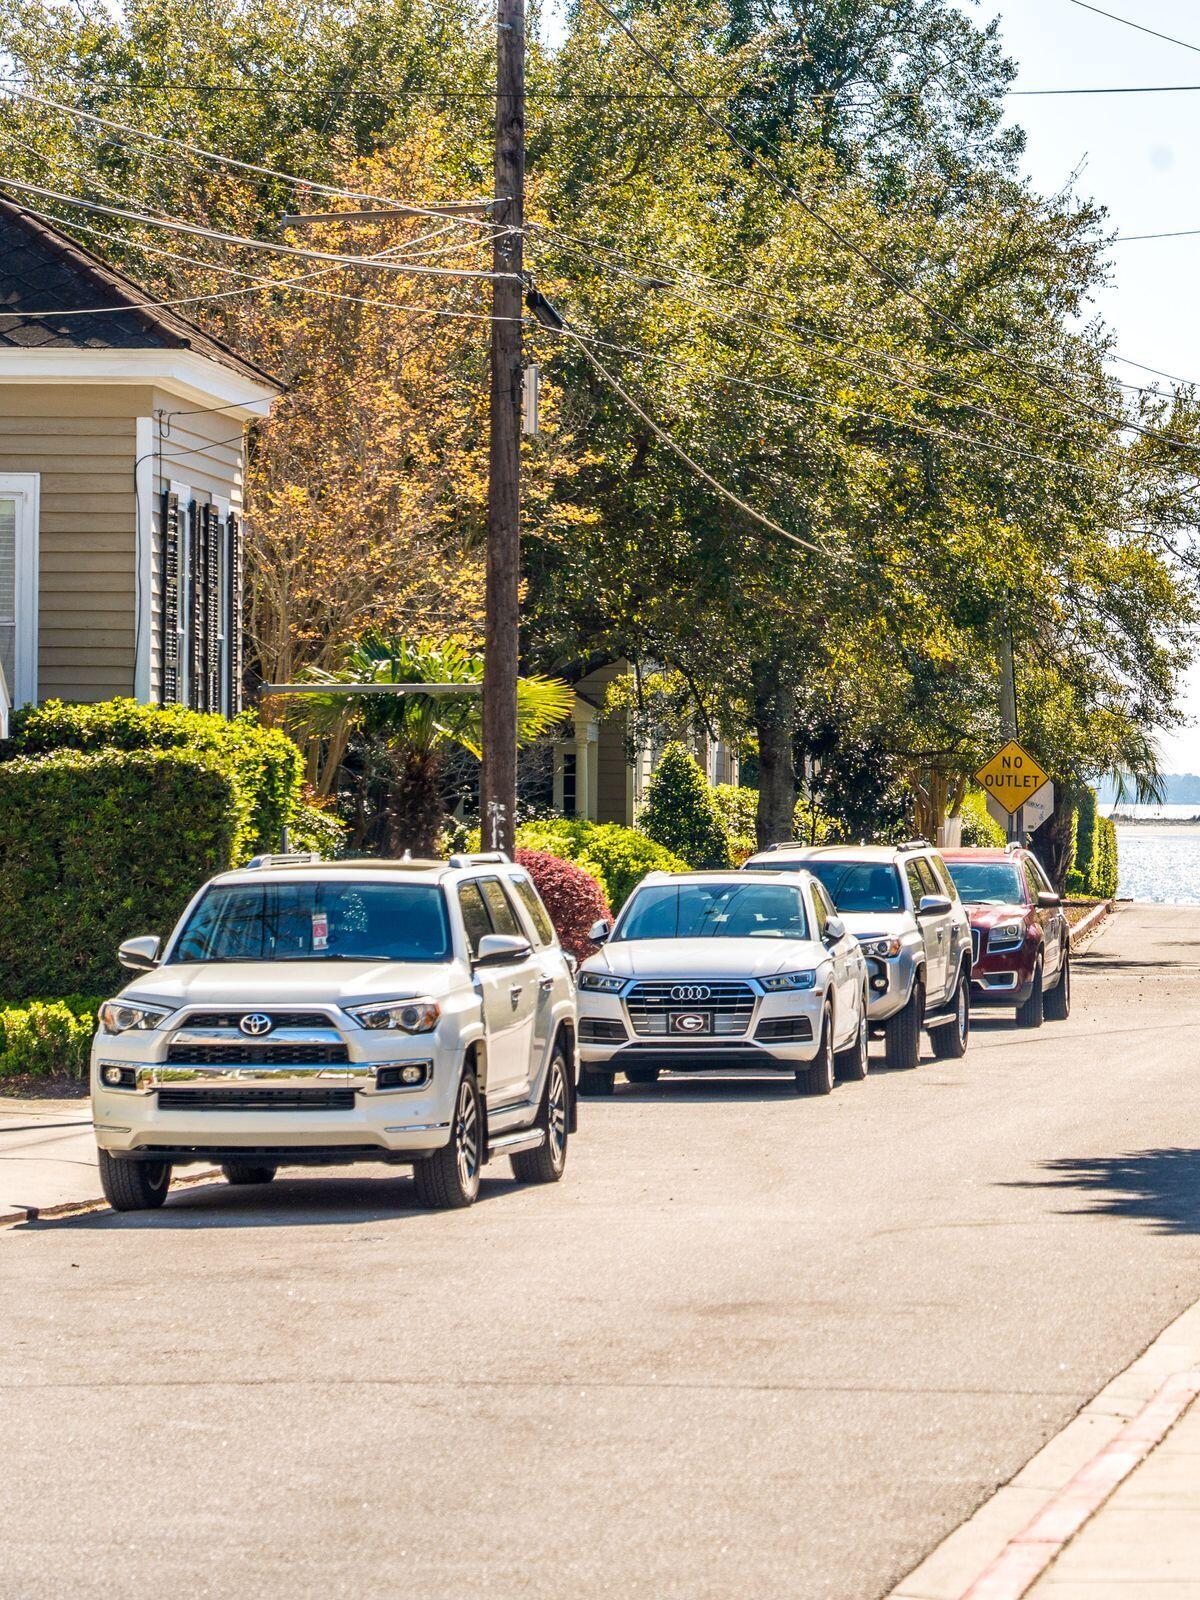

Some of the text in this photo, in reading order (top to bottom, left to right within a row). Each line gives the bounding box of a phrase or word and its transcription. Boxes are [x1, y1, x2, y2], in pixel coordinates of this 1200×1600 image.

[1002, 756, 1023, 769] NO
[984, 774, 1040, 788] OUTLET
[681, 1016, 703, 1029] G
